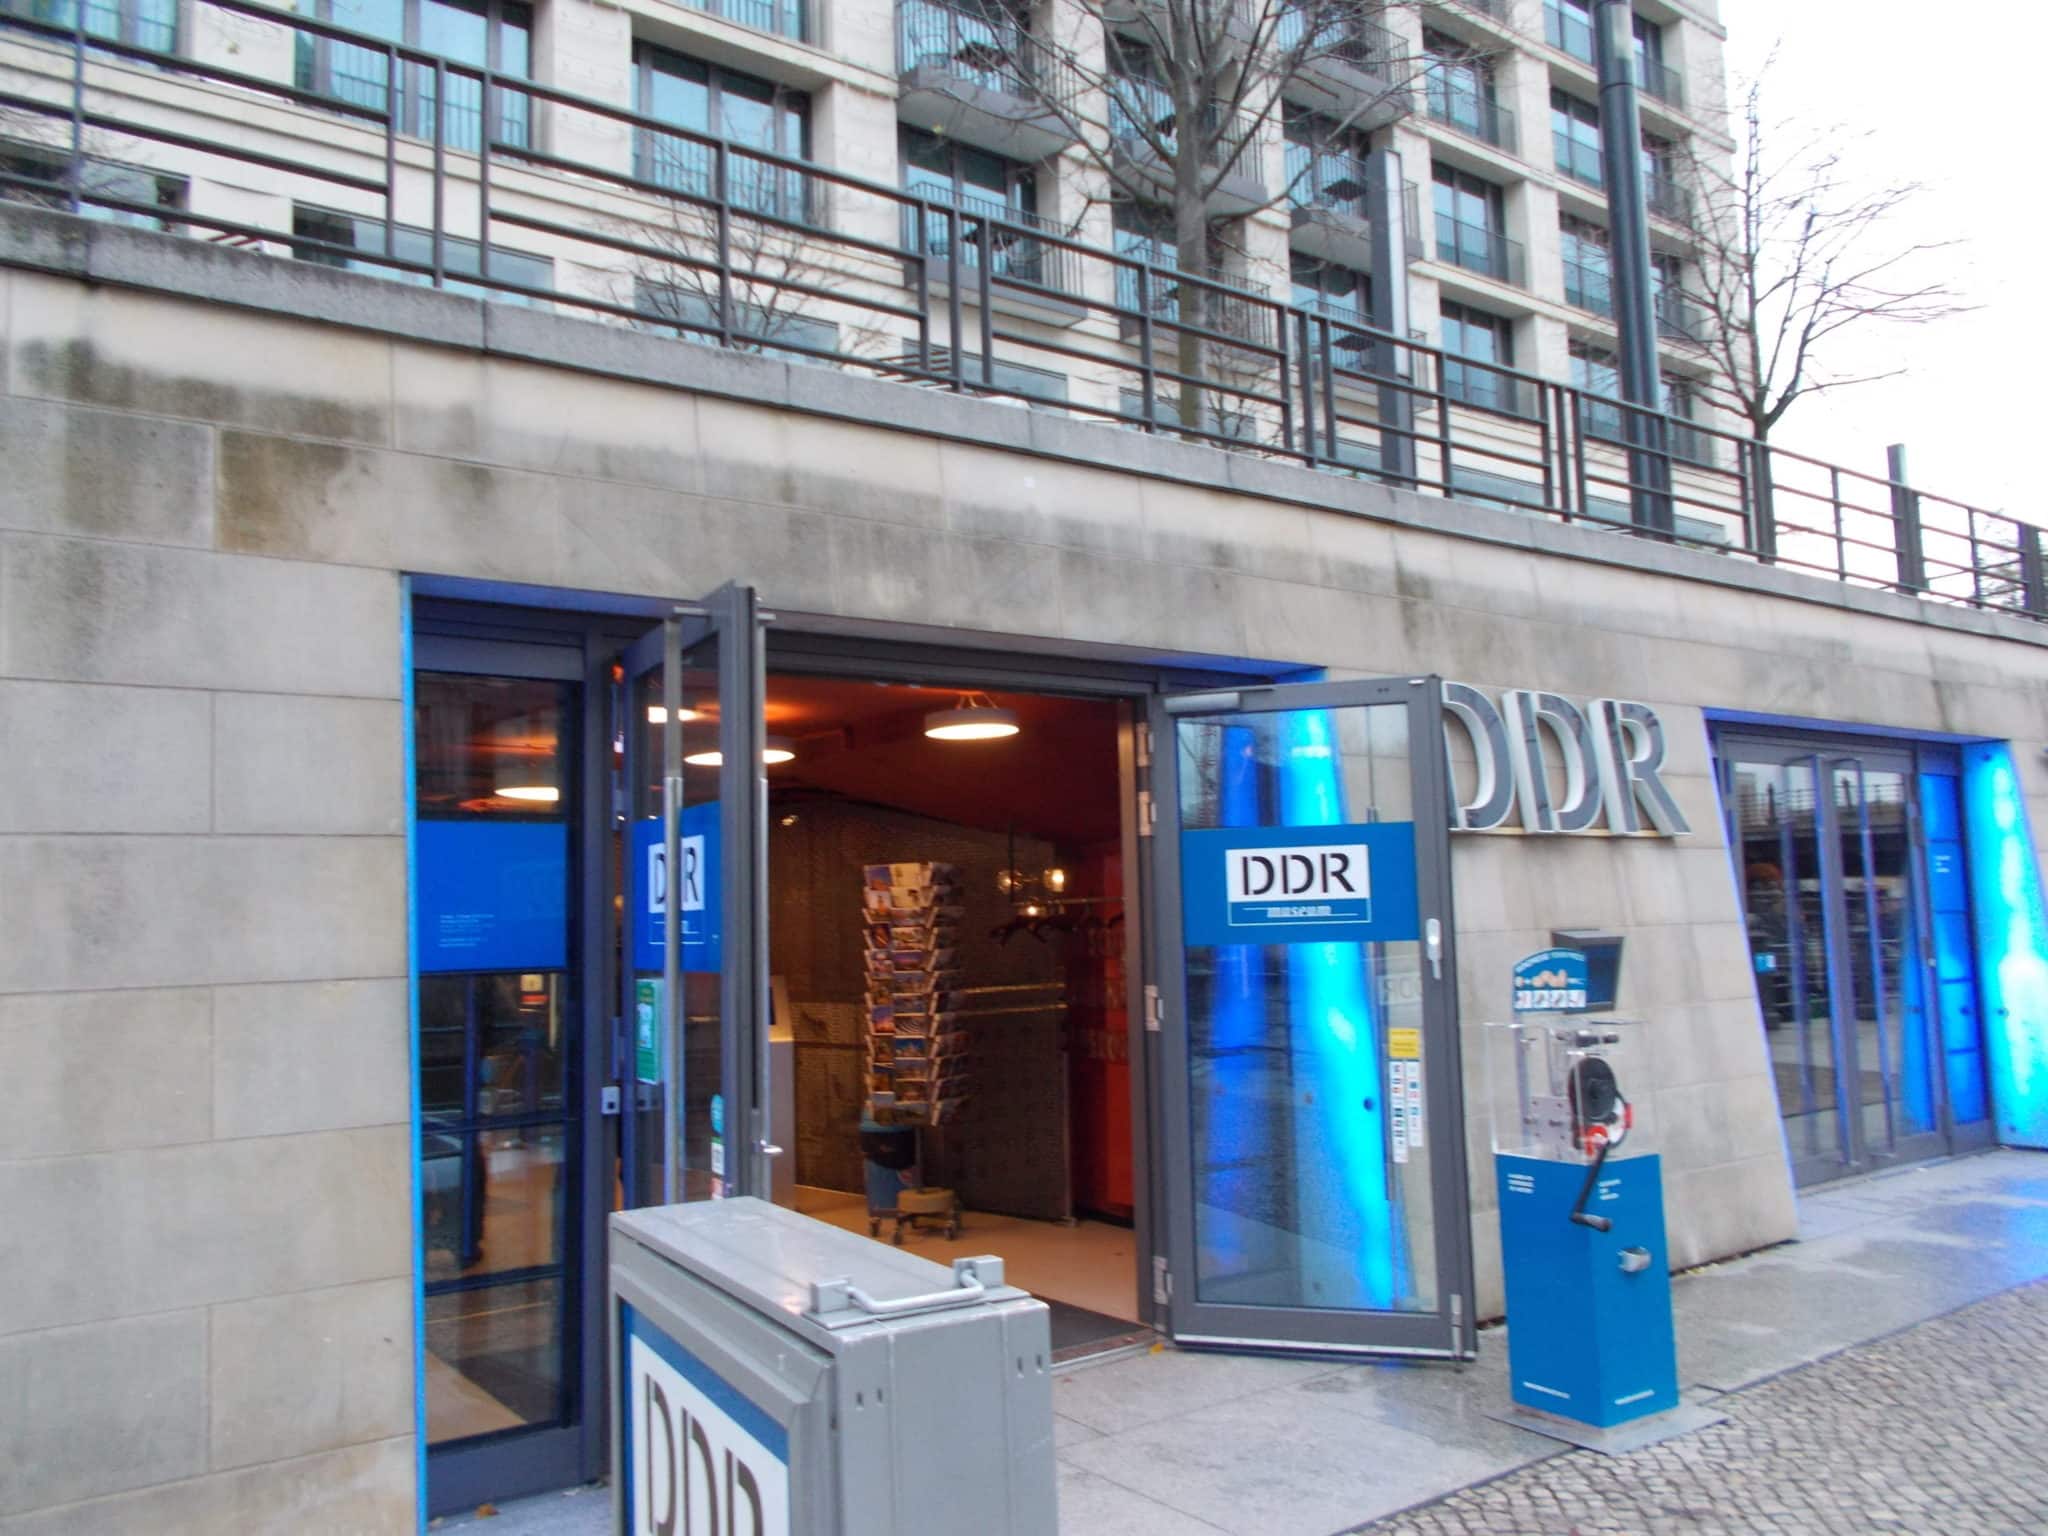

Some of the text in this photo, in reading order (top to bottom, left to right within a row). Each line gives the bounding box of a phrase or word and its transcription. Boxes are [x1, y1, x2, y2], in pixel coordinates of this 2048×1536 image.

[1441, 681, 1694, 836] DDR
[654, 847, 699, 905] DR
[1242, 853, 1356, 896] DDR
